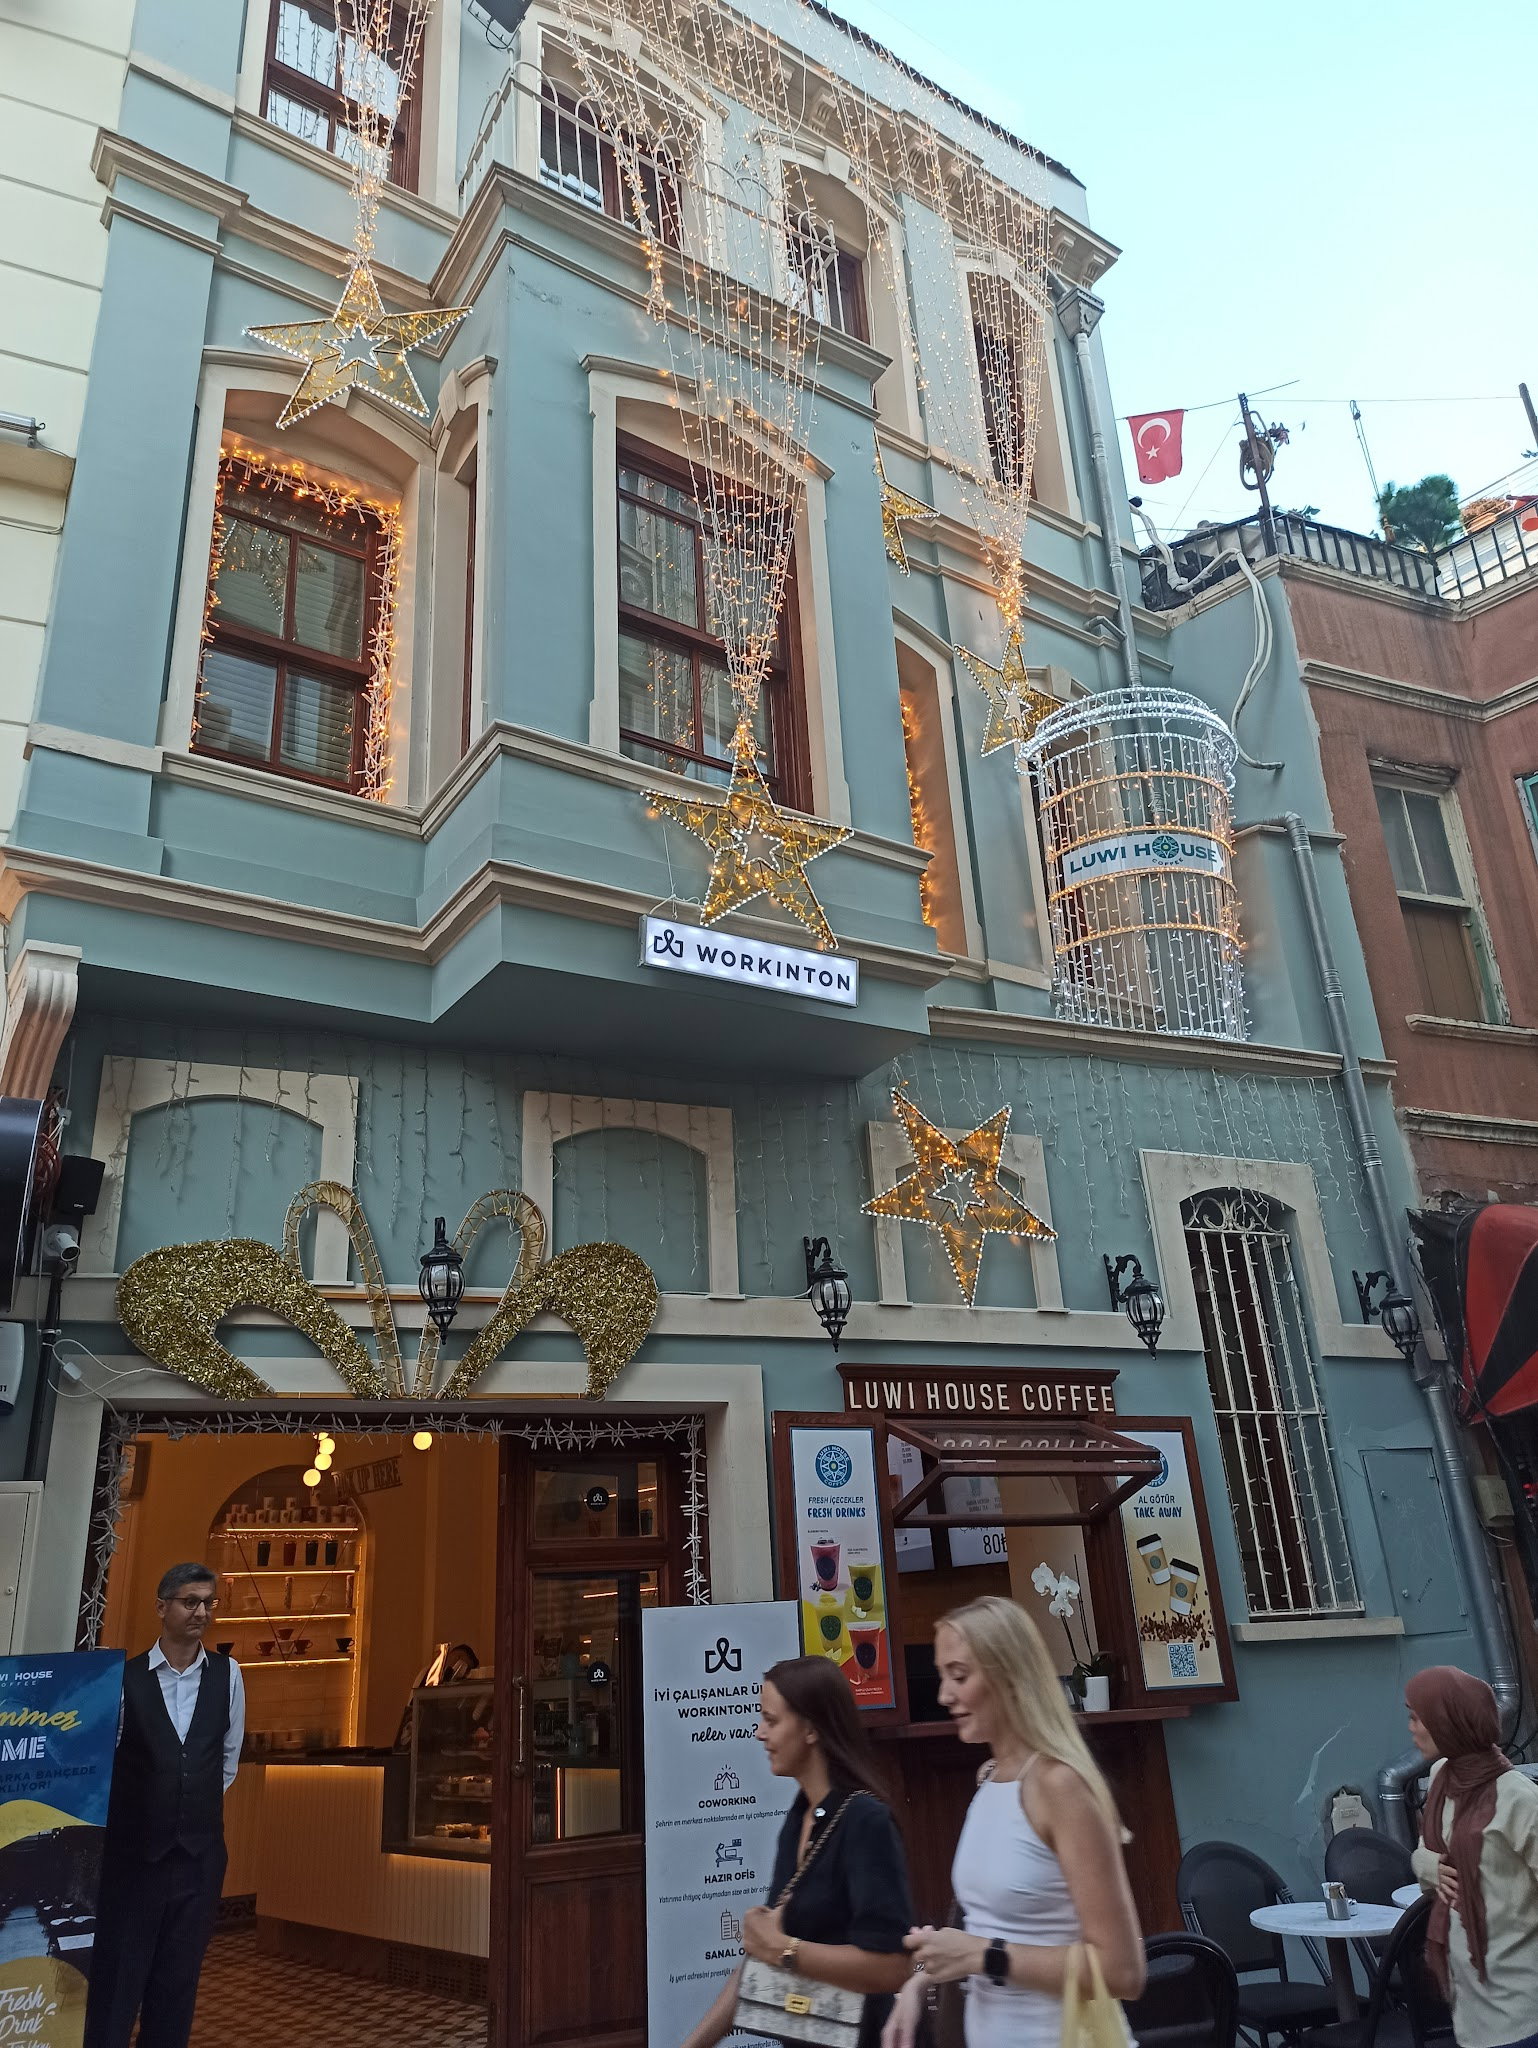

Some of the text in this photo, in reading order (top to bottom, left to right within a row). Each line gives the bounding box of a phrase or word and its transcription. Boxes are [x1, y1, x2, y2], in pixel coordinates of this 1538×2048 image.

[1069, 835, 1218, 874] LUWI HOUSE
[1151, 857, 1184, 866] COFFEE
[697, 944, 850, 991] WORKINTON
[848, 1381, 1115, 1412] LUWI HOUSE COFFEE
[373, 1459, 401, 1488] HERE
[808, 1495, 864, 1505] FRESH İÇECEKLER
[1149, 1494, 1175, 1503] GÖTÜR
[807, 1507, 866, 1518] FRESH DRINKS
[1134, 1506, 1182, 1518] TAKE AWAY
[15, 1670, 54, 1680] HOUSE
[654, 1687, 670, 1702] İYİ
[673, 1686, 748, 1703] ÇALIŞANLAR
[691, 1723, 759, 1742] neler var?
[36, 1765, 97, 1779] BAHÇEDE
[698, 1796, 757, 1808] COWORKING
[704, 1868, 755, 1884] HAZIR OFİS
[705, 1948, 736, 1960] SANAL
[0, 1984, 46, 2012] Fresh
[0, 2012, 44, 2040] Drink
